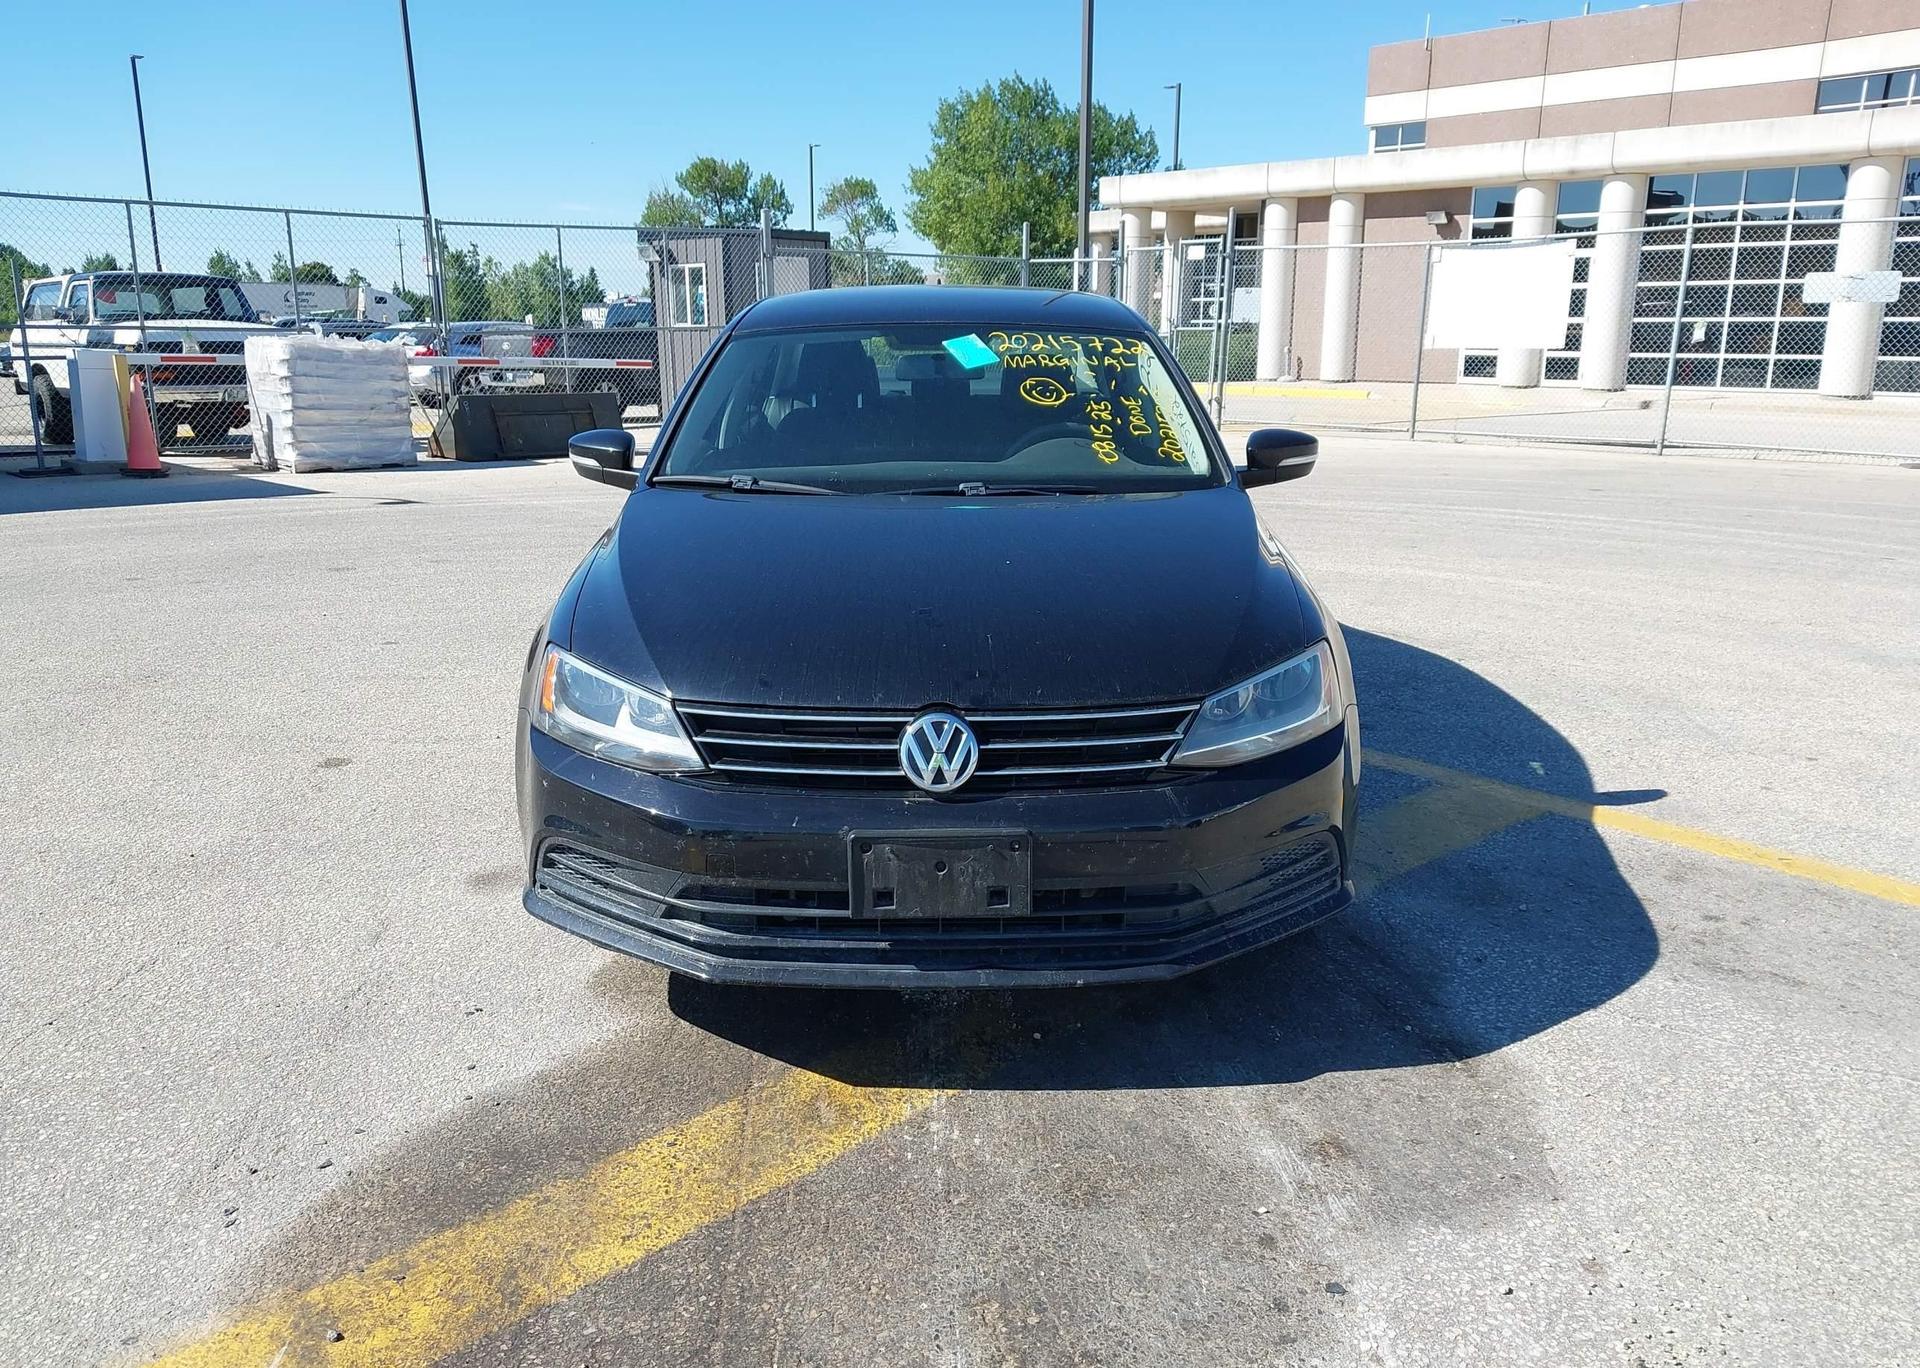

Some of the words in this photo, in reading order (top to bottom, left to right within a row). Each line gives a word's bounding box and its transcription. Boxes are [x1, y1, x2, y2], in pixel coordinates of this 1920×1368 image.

[988, 331, 1146, 354] 20215722
[1004, 354, 1136, 372] MARGINAL
[1120, 396, 1152, 436] DONE
